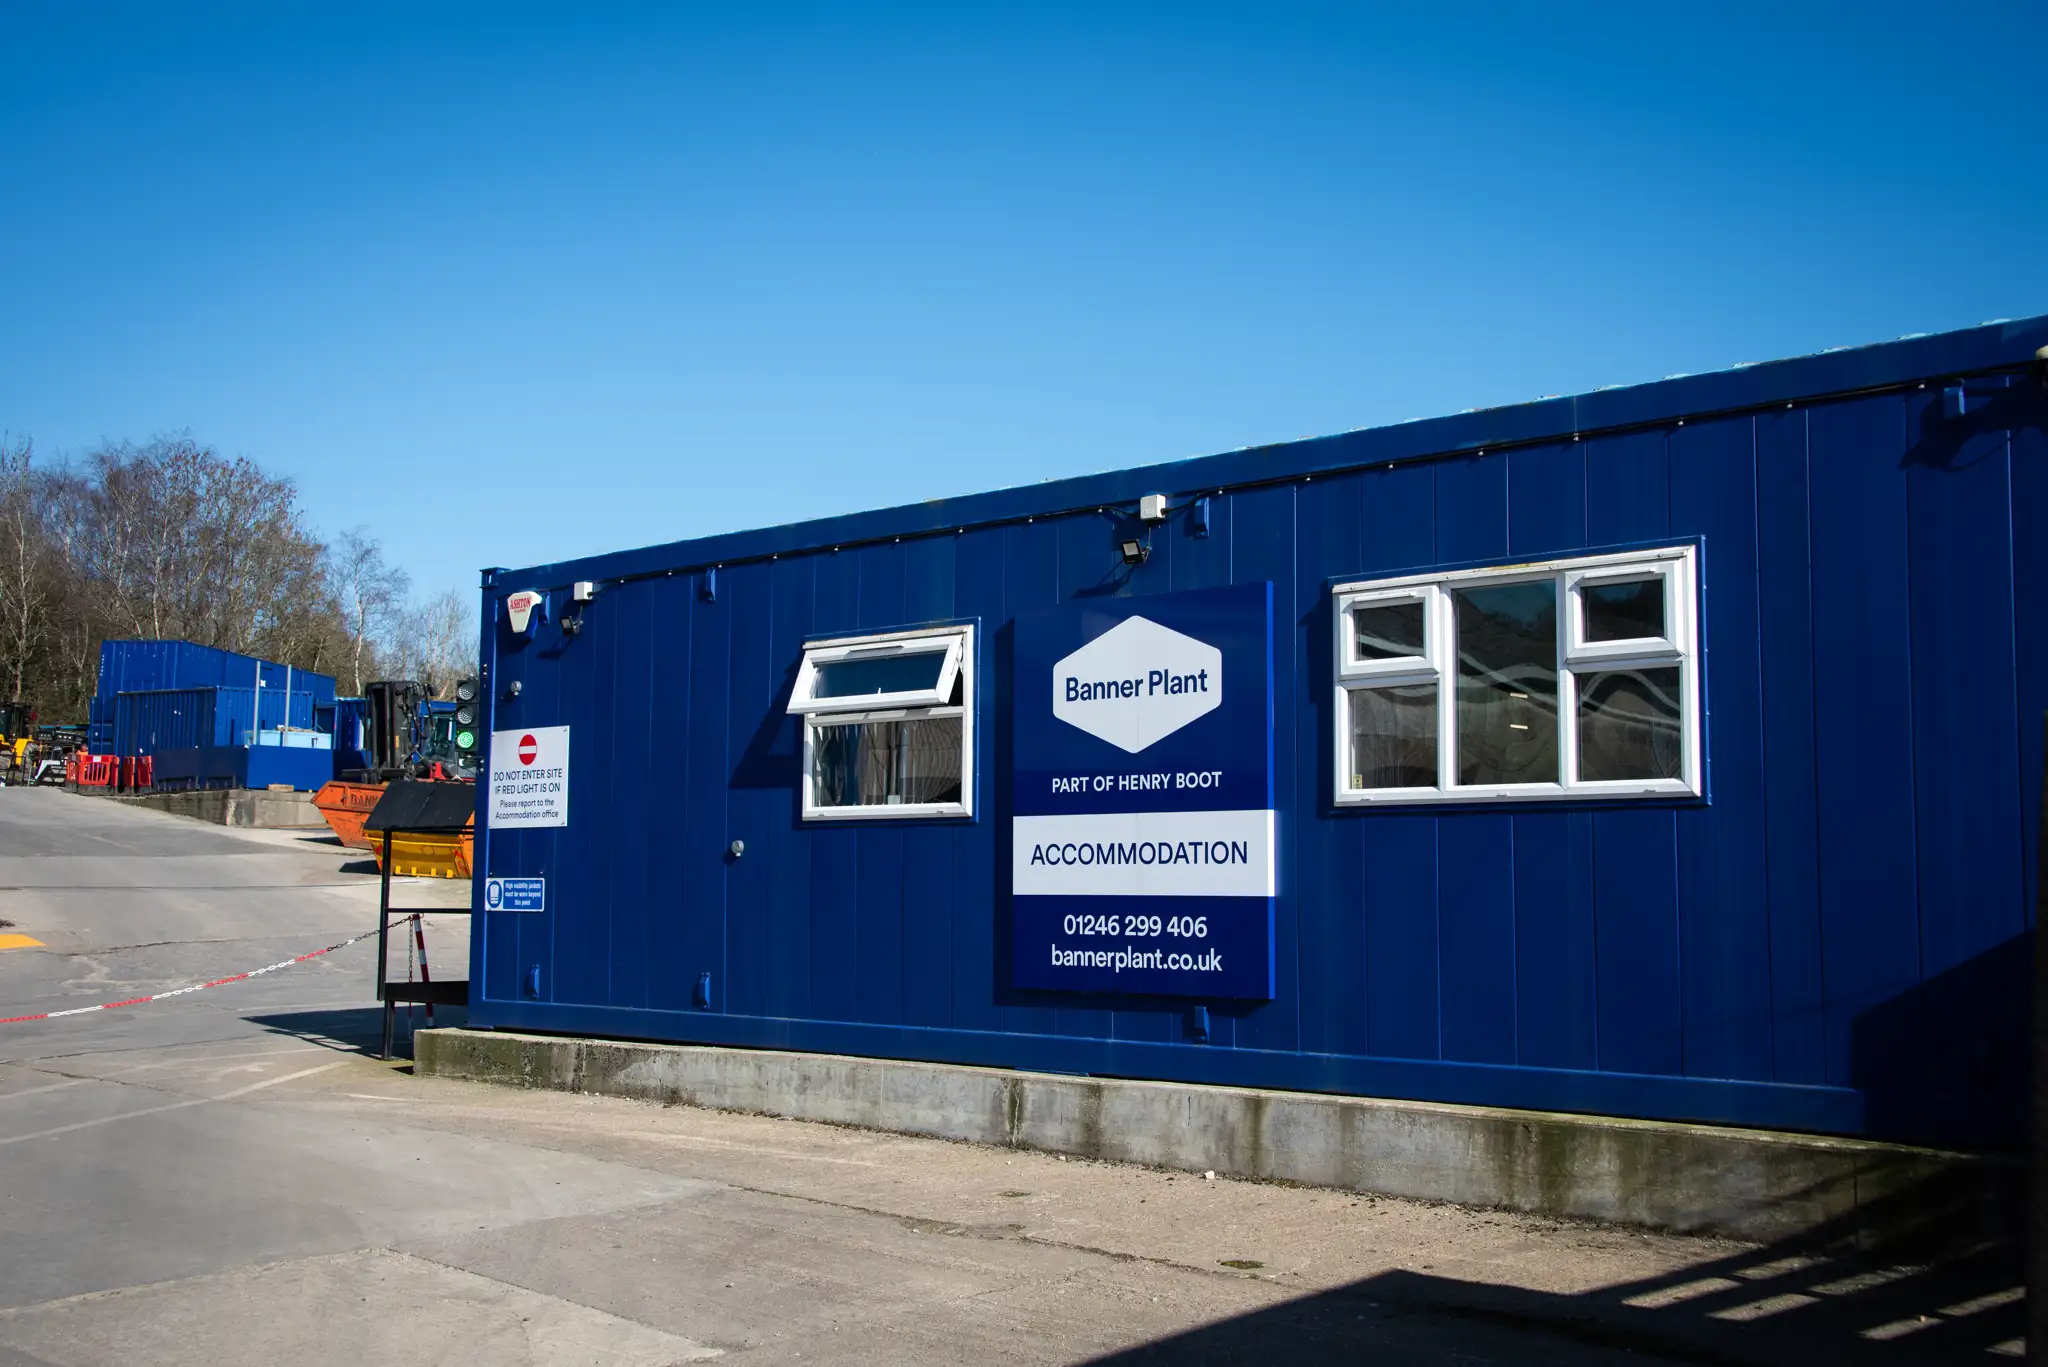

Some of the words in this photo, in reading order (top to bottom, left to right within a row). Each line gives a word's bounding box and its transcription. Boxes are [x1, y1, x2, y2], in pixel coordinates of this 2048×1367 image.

[510, 597, 531, 609] ASHTON
[1066, 677, 1143, 701] Banner
[1149, 669, 1207, 695] Plant
[494, 772, 504, 781] DO
[506, 771, 520, 780] NOT
[522, 769, 545, 780] ENTER
[547, 768, 562, 778] SITE
[1052, 777, 1089, 793] PART
[1093, 776, 1114, 792] OF
[1119, 773, 1171, 790] HENRY
[1176, 771, 1222, 788] BOOT
[495, 786, 500, 794] IF
[502, 785, 515, 794] RED
[517, 784, 538, 794] LIGHT
[540, 783, 546, 792] IS
[549, 782, 560, 792] ON
[500, 800, 517, 808] Please
[519, 800, 536, 808] report
[545, 798, 554, 806] the
[496, 810, 540, 819] Accommodation
[542, 810, 558, 818] office
[1030, 841, 1248, 865] ACCOMMODATION
[1064, 914, 1120, 936] 01246
[1125, 915, 1162, 937] 299
[1167, 916, 1207, 938] 406
[1052, 944, 1222, 973] bannerplant.co.uk
